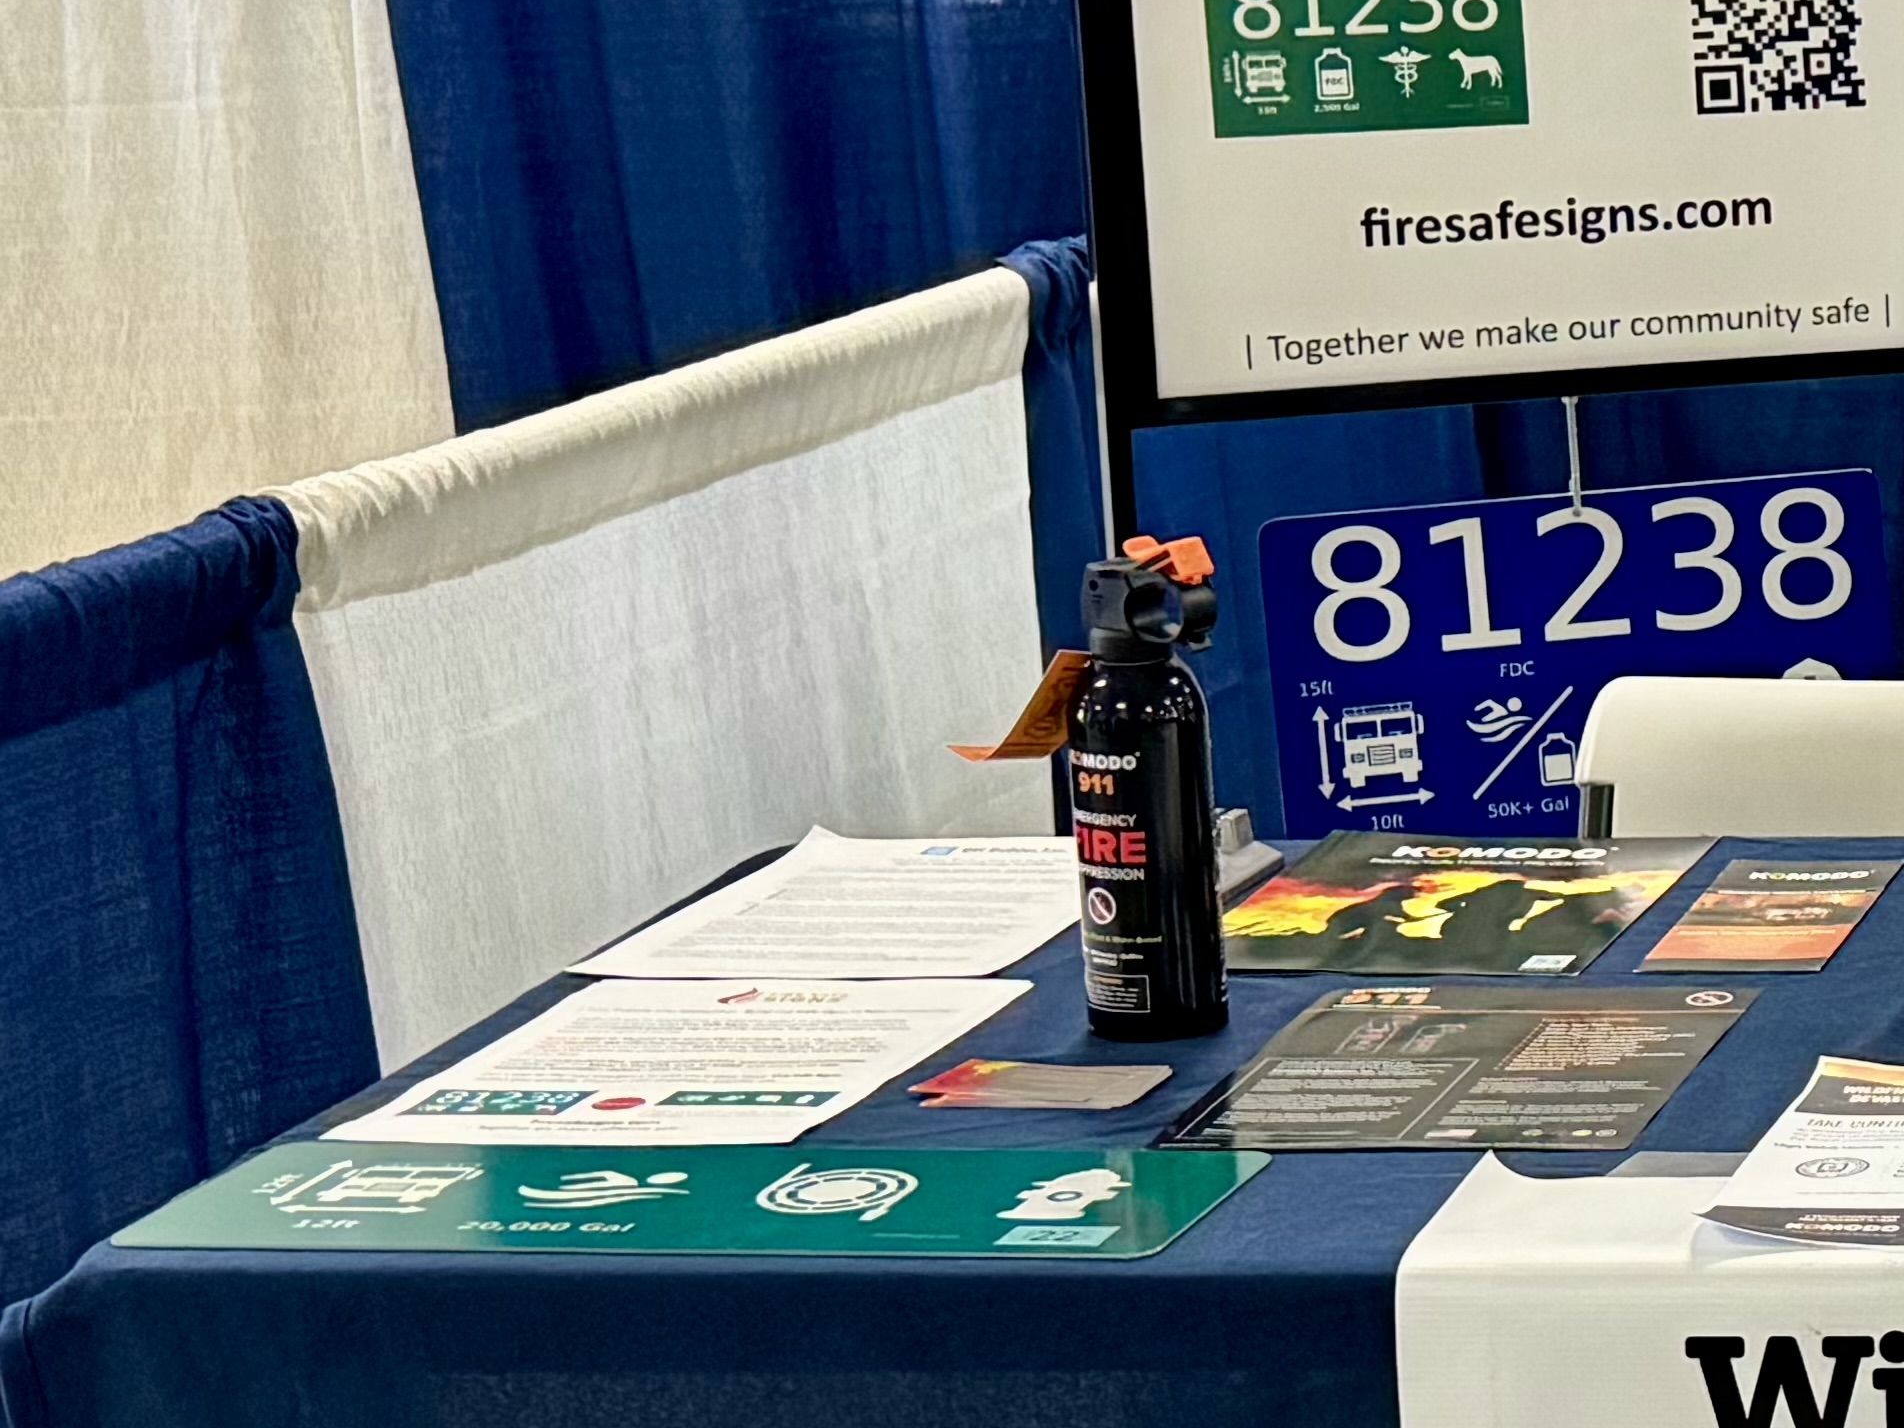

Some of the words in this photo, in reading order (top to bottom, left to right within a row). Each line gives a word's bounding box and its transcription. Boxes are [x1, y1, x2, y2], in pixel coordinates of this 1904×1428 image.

[1359, 197, 1772, 248] firesafesigns.com
[1266, 327, 1410, 365] Together
[1418, 328, 1465, 351] we
[1476, 316, 1558, 348] make
[1568, 318, 1621, 341] our
[1630, 302, 1802, 337] community
[1812, 296, 1870, 326] safe
[1311, 487, 1852, 662] 81238
[1499, 661, 1535, 677] FDC
[1300, 680, 1335, 698] 15ft
[1078, 772, 1114, 795] 911
[1488, 801, 1534, 819] 50K+
[1541, 798, 1570, 814] Gal
[1371, 813, 1405, 829] 10ft
[1392, 846, 1607, 859] KOMODO
[292, 1219, 360, 1229] 12ft
[458, 1221, 571, 1232] 20,000
[579, 1222, 635, 1233] Gal
